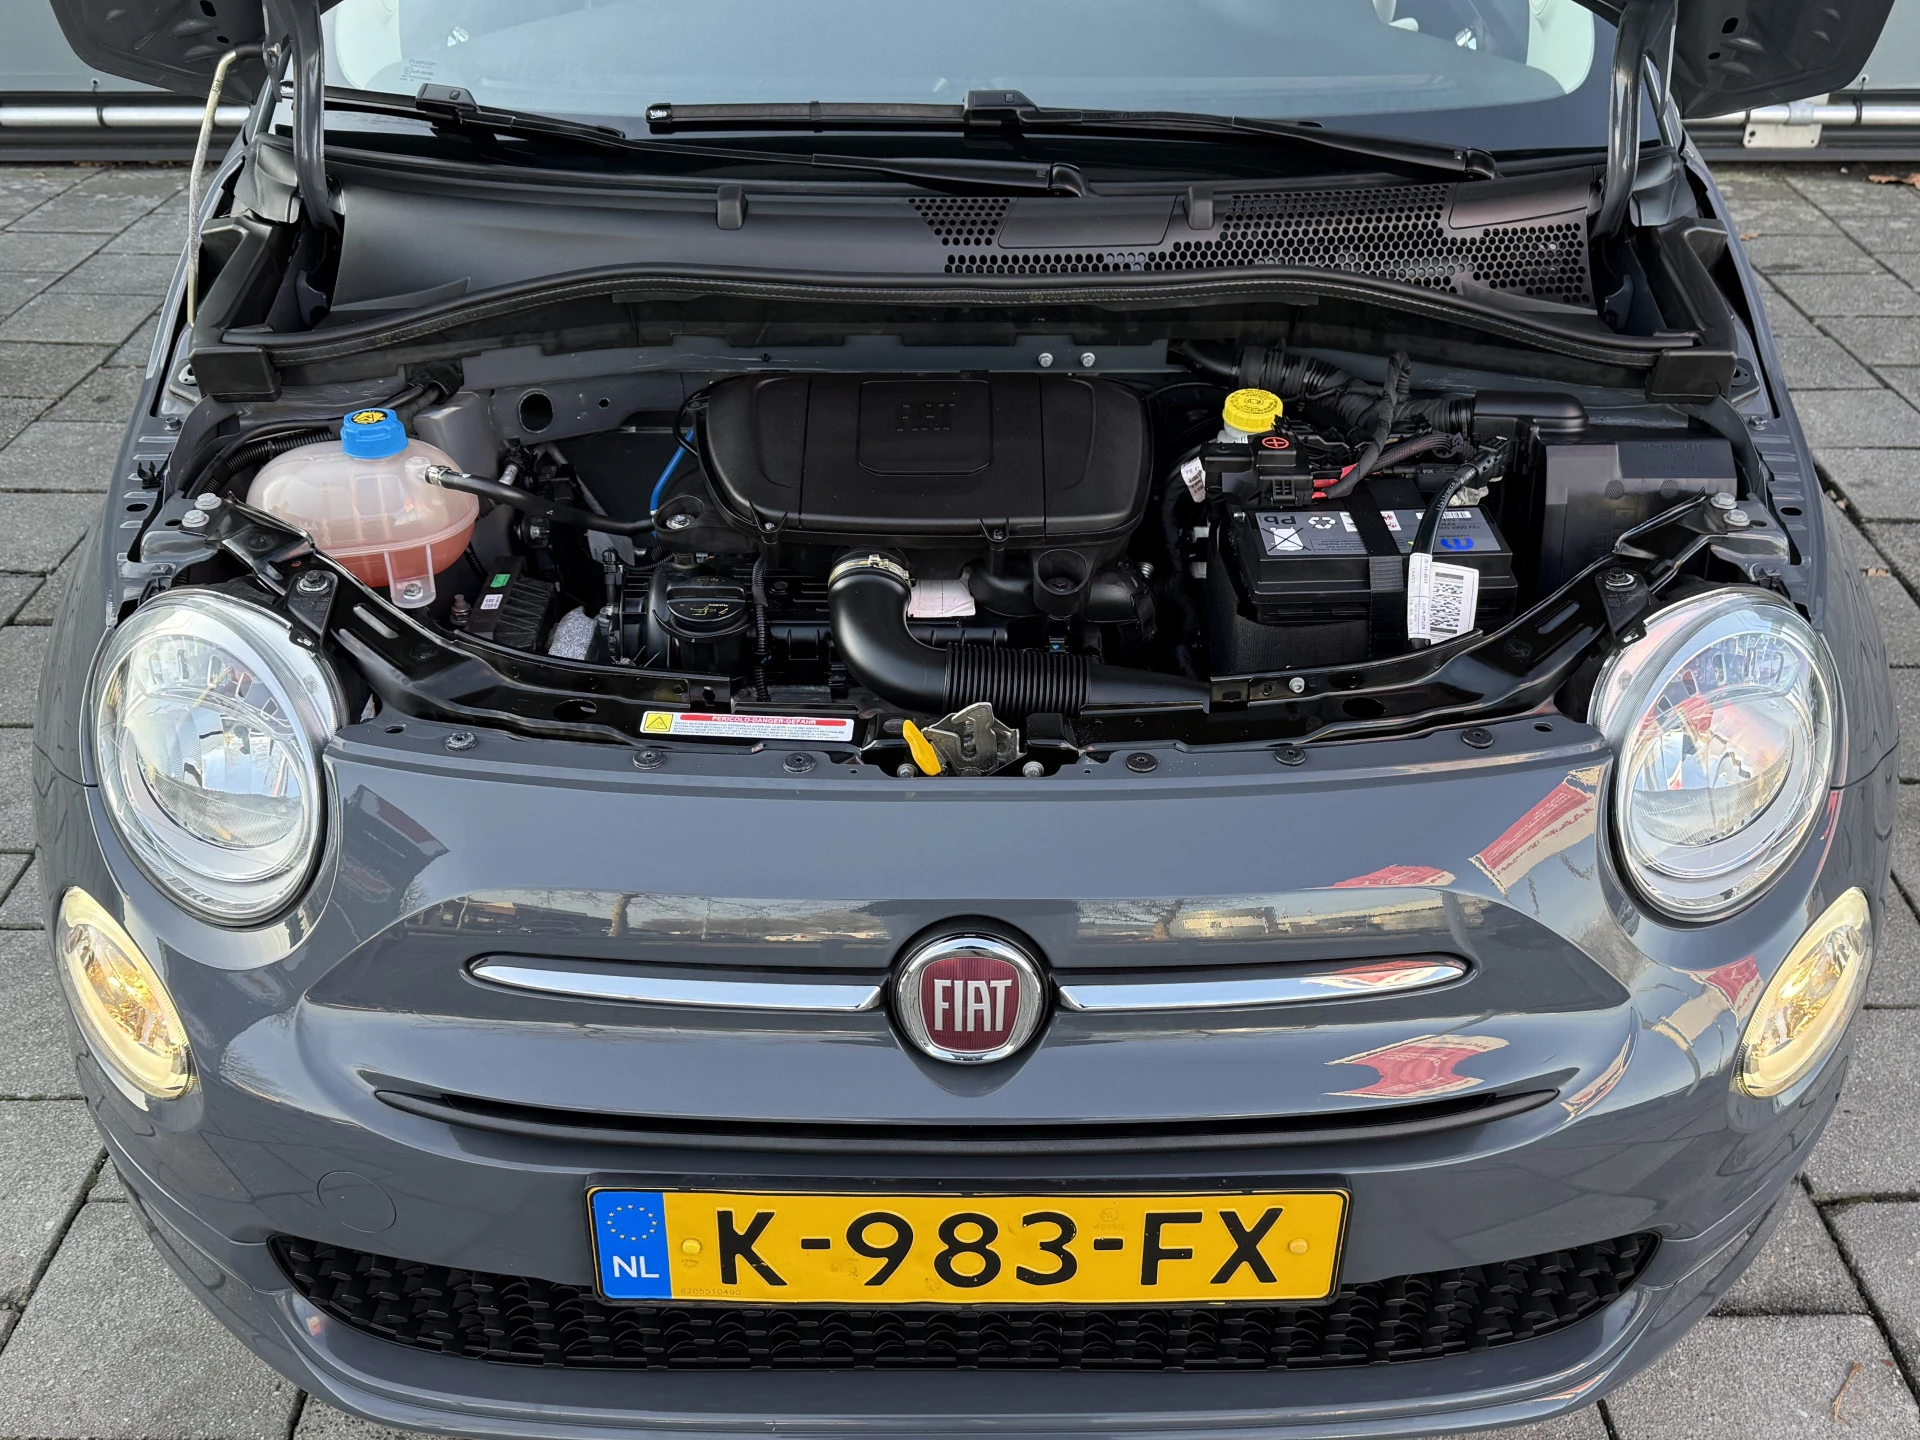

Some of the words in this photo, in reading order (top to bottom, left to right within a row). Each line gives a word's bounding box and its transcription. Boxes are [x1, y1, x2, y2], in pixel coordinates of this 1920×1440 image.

[1263, 515, 1297, 525] Pb
[712, 715, 817, 726] PERICOLO-DANGER-GEFAHR
[933, 979, 1013, 1032] FIAT
[715, 1207, 1286, 1287] K-983-FX
[611, 1256, 661, 1279] NL
